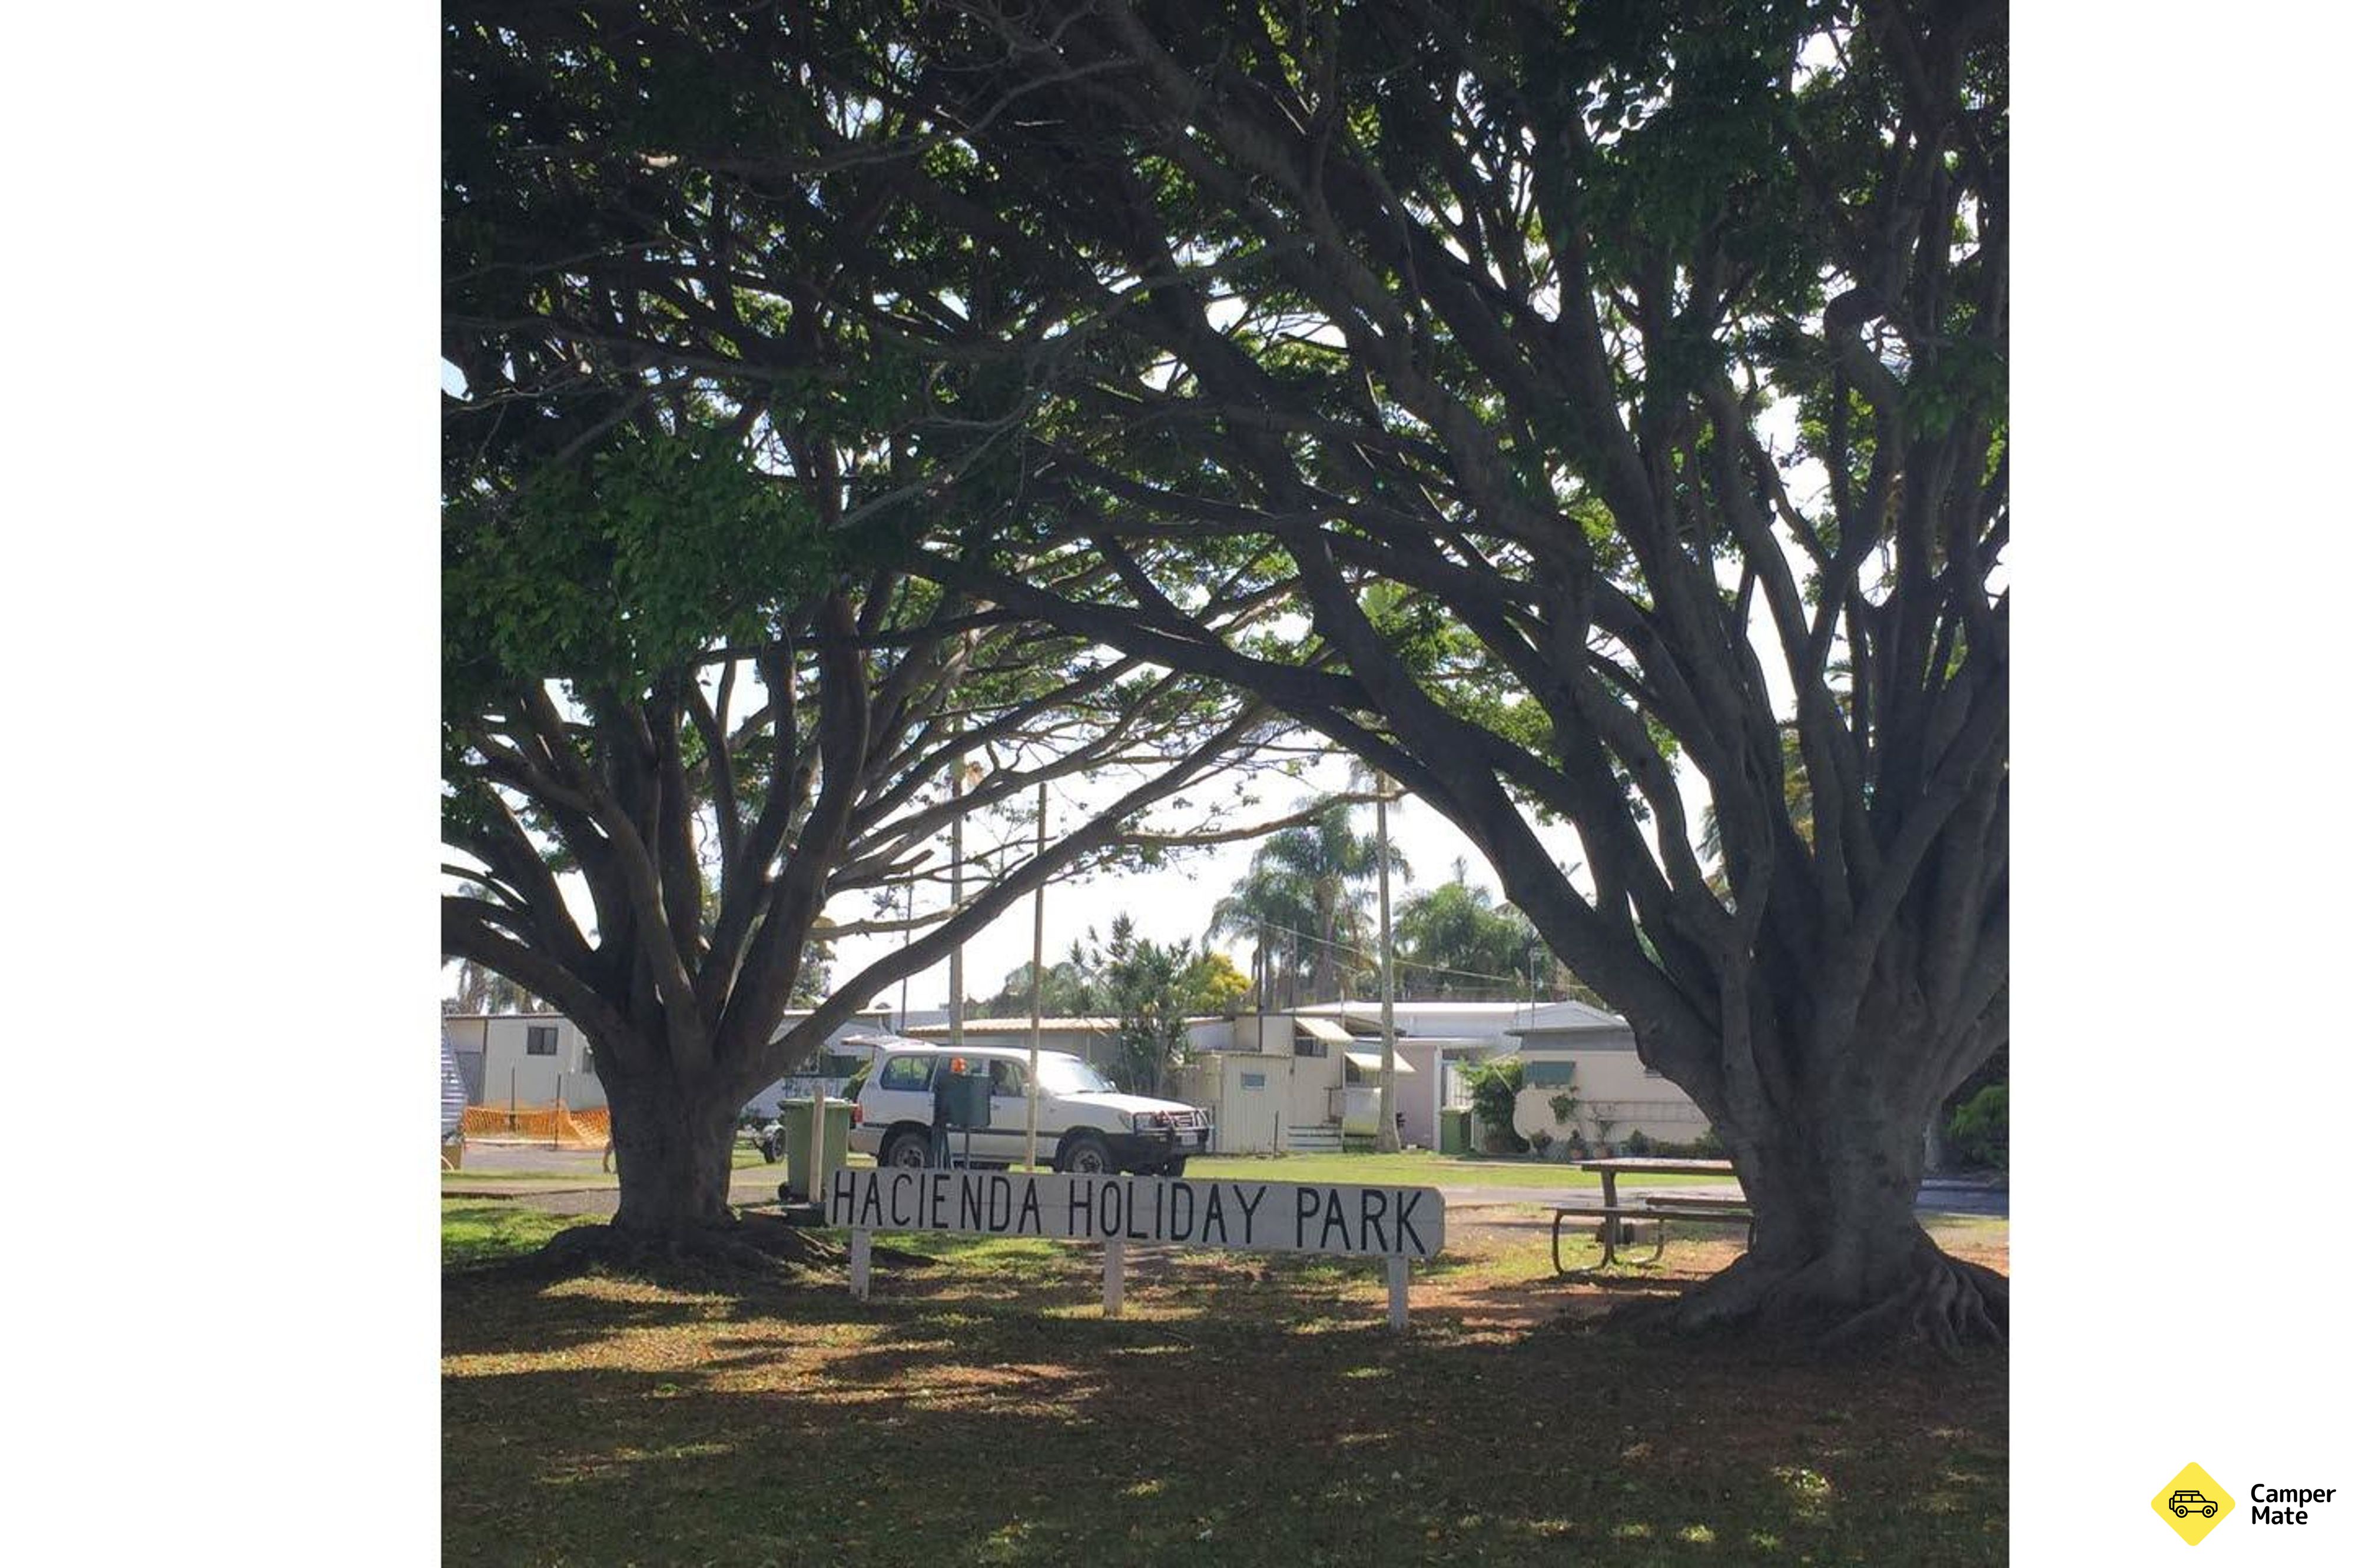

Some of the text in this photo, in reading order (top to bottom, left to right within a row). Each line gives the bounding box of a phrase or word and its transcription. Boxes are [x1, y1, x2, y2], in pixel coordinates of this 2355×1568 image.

[832, 1171, 1426, 1255] HACIENDA HOLIDAY PARK
